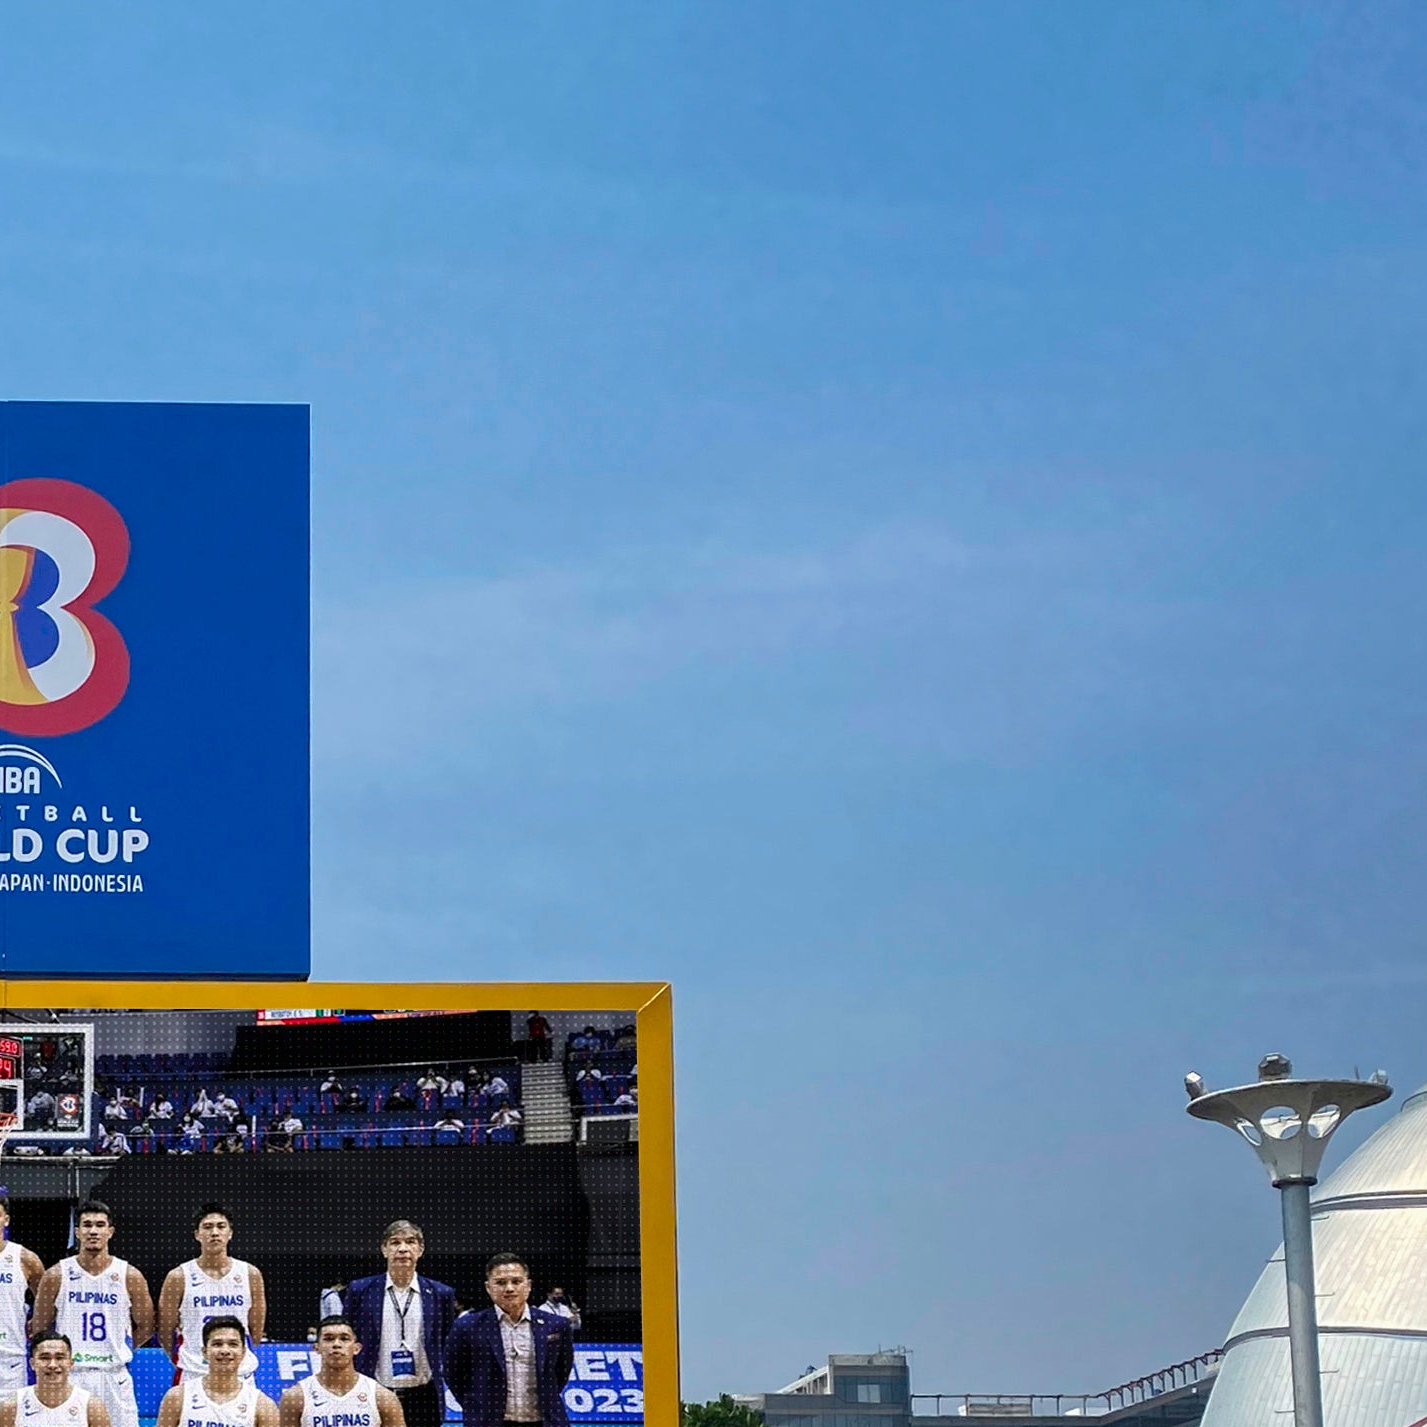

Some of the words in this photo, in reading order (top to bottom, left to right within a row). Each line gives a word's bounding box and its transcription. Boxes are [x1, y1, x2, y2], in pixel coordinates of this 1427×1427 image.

[56, 828, 149, 863] CUP
[68, 1291, 118, 1305] PILIPINAS
[193, 1295, 244, 1308] PILIPINAS
[82, 1312, 106, 1341] 18
[84, 1353, 113, 1363] Smart
[563, 1388, 643, 1414] 023
